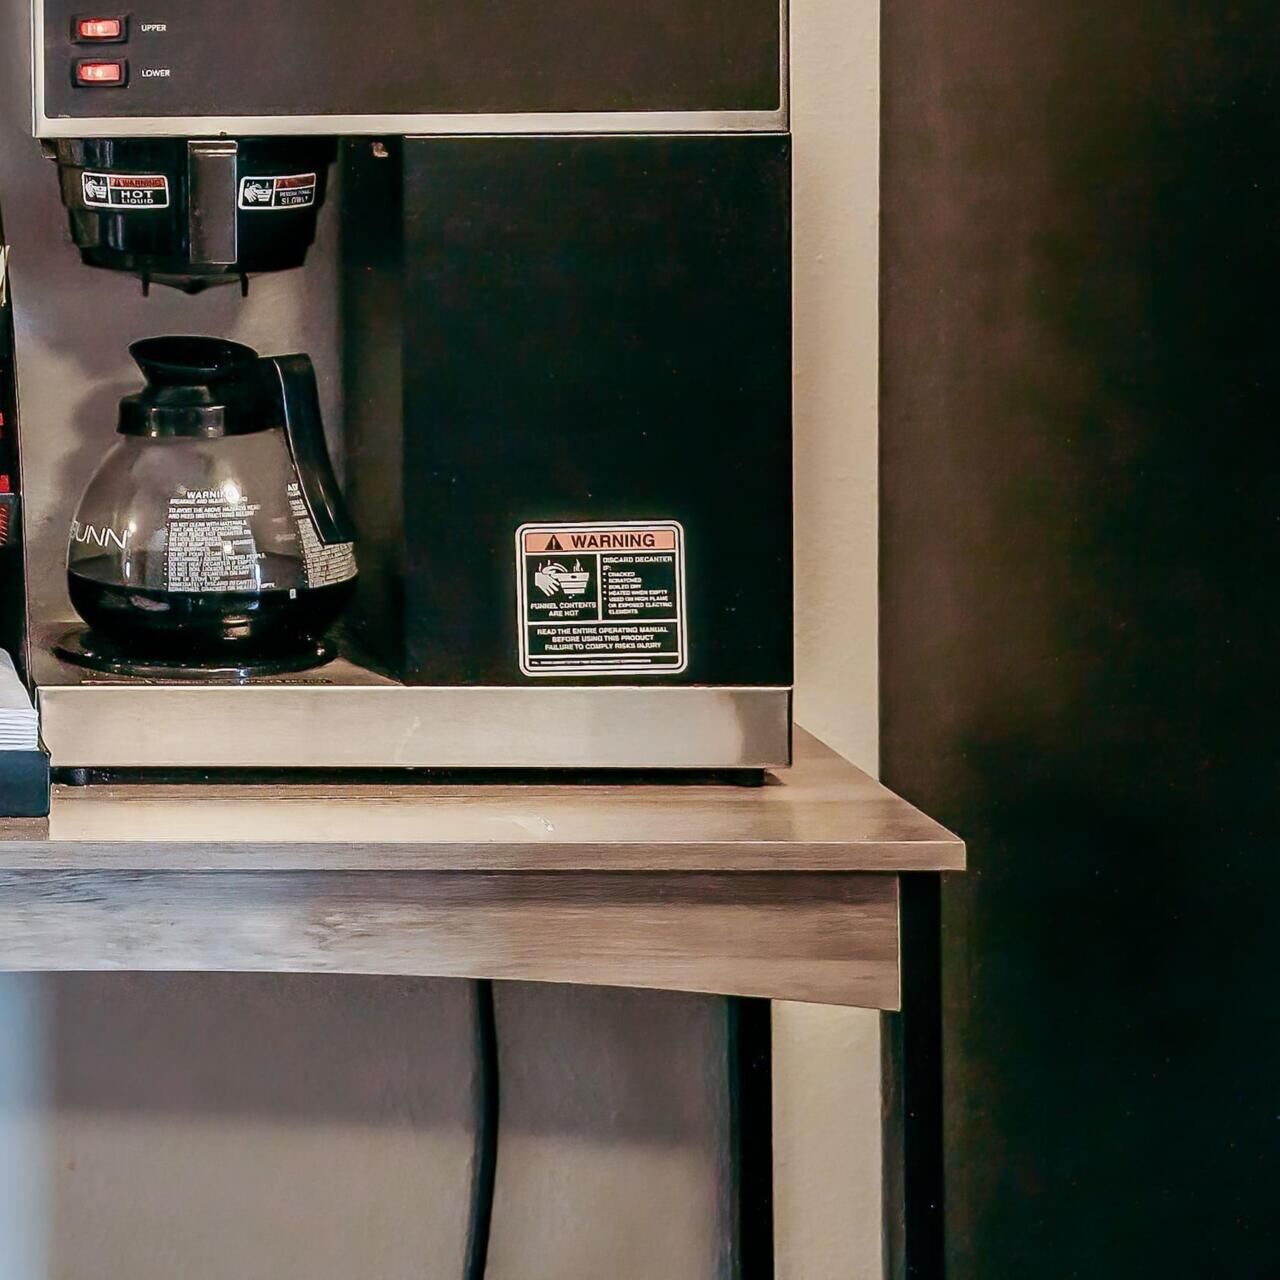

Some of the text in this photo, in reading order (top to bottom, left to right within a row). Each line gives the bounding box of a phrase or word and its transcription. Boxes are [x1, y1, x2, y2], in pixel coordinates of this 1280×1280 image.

[141, 24, 167, 32] UPPER
[141, 69, 171, 78] LOWER
[121, 190, 154, 199] HOT
[186, 490, 230, 499] WARNI
[571, 533, 656, 548] WARNING
[634, 555, 673, 563] DECANTER
[559, 601, 597, 609] CONTENTS
[598, 626, 638, 634] OPERATING
